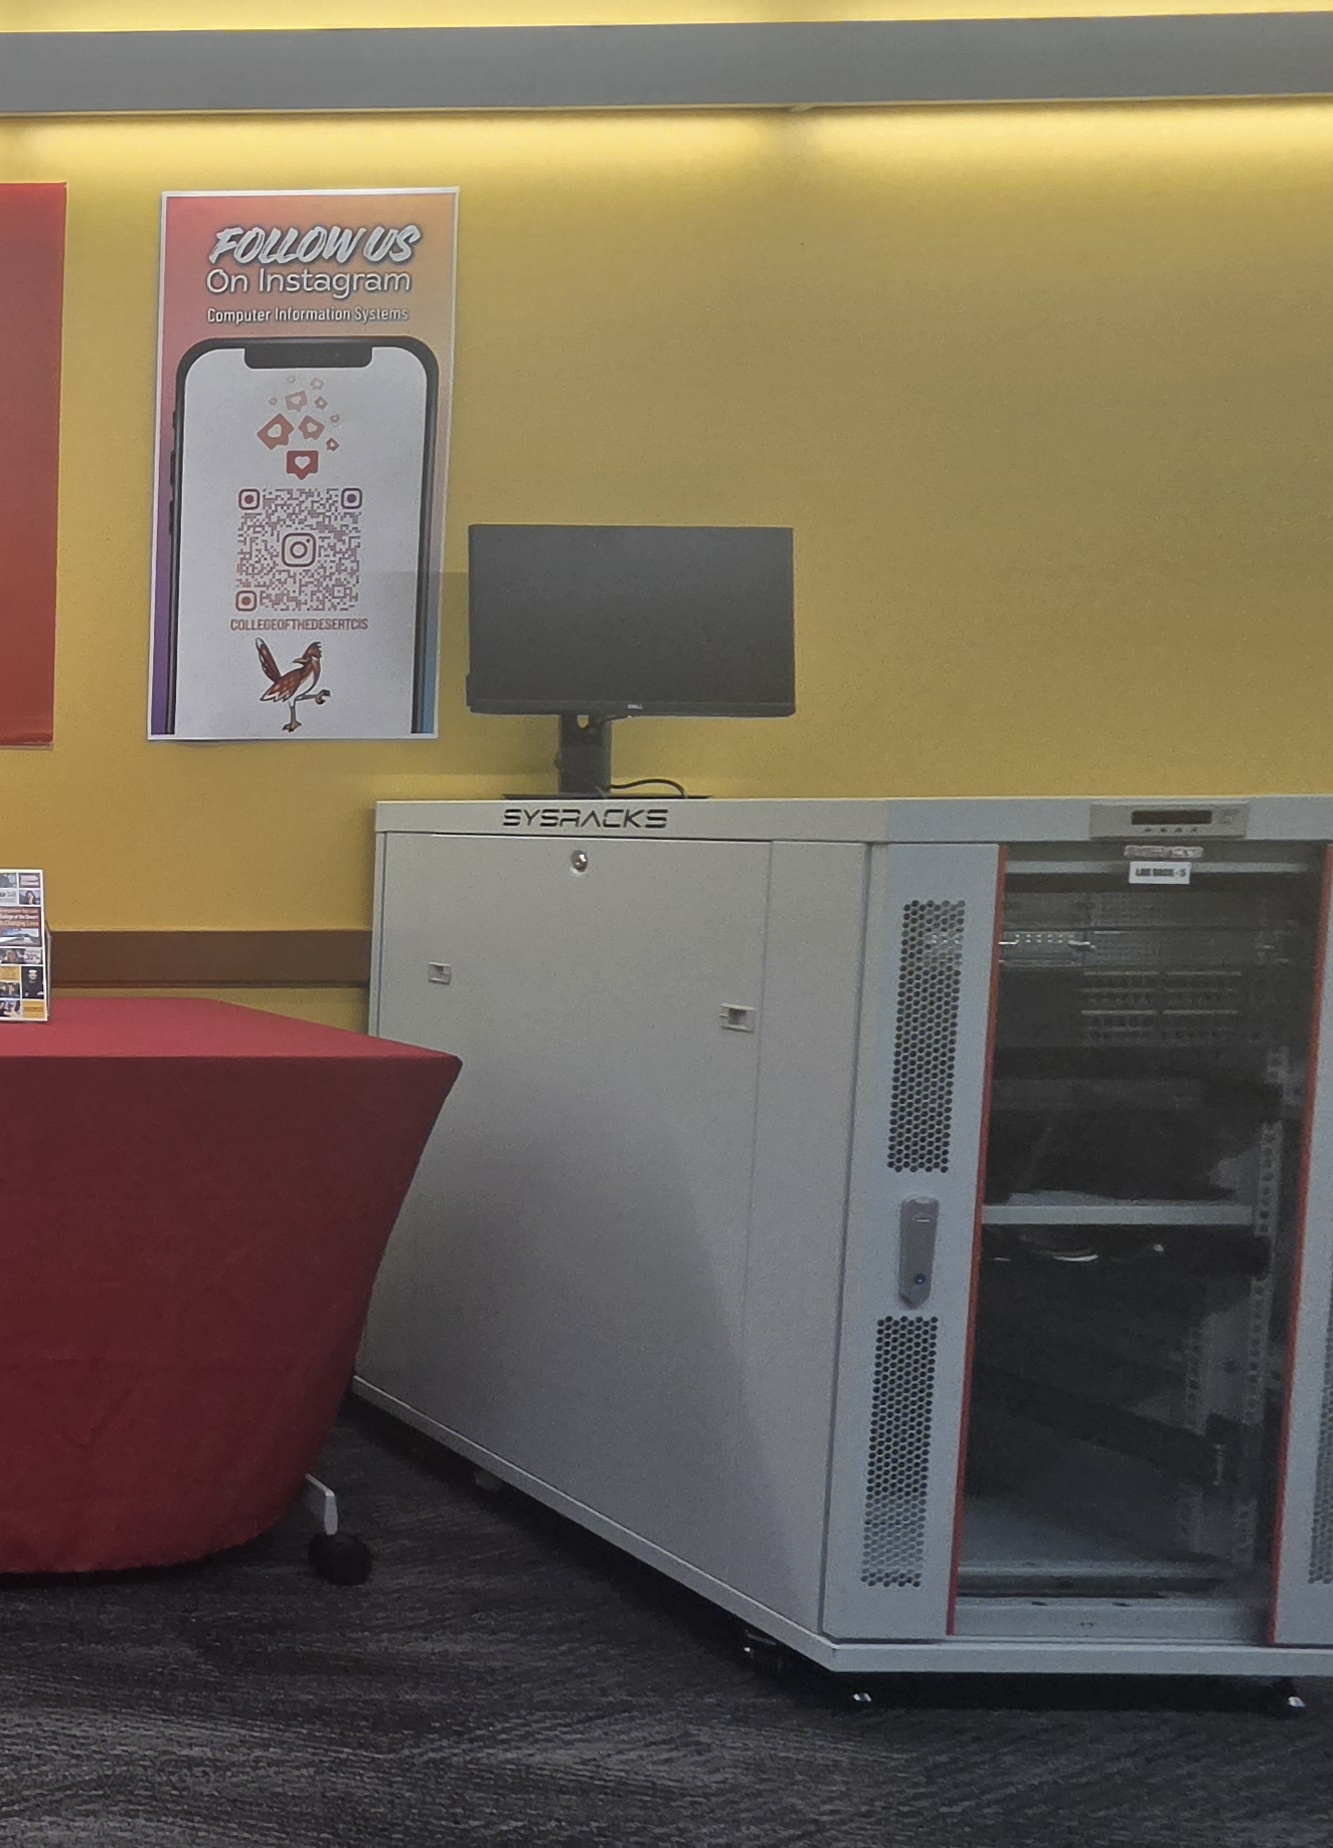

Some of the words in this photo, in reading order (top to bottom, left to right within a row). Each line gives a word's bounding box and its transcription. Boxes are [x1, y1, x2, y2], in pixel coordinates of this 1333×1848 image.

[209, 225, 365, 264] FOLLOW
[363, 225, 421, 263] US
[207, 269, 249, 293] On
[258, 269, 411, 299] Instagram
[207, 308, 271, 324] Computer
[275, 307, 351, 322] Information
[354, 306, 408, 324] Systems
[230, 618, 369, 631] COLLEGEOFTHEDESERTCIS
[501, 808, 669, 829] SYSRACKS
